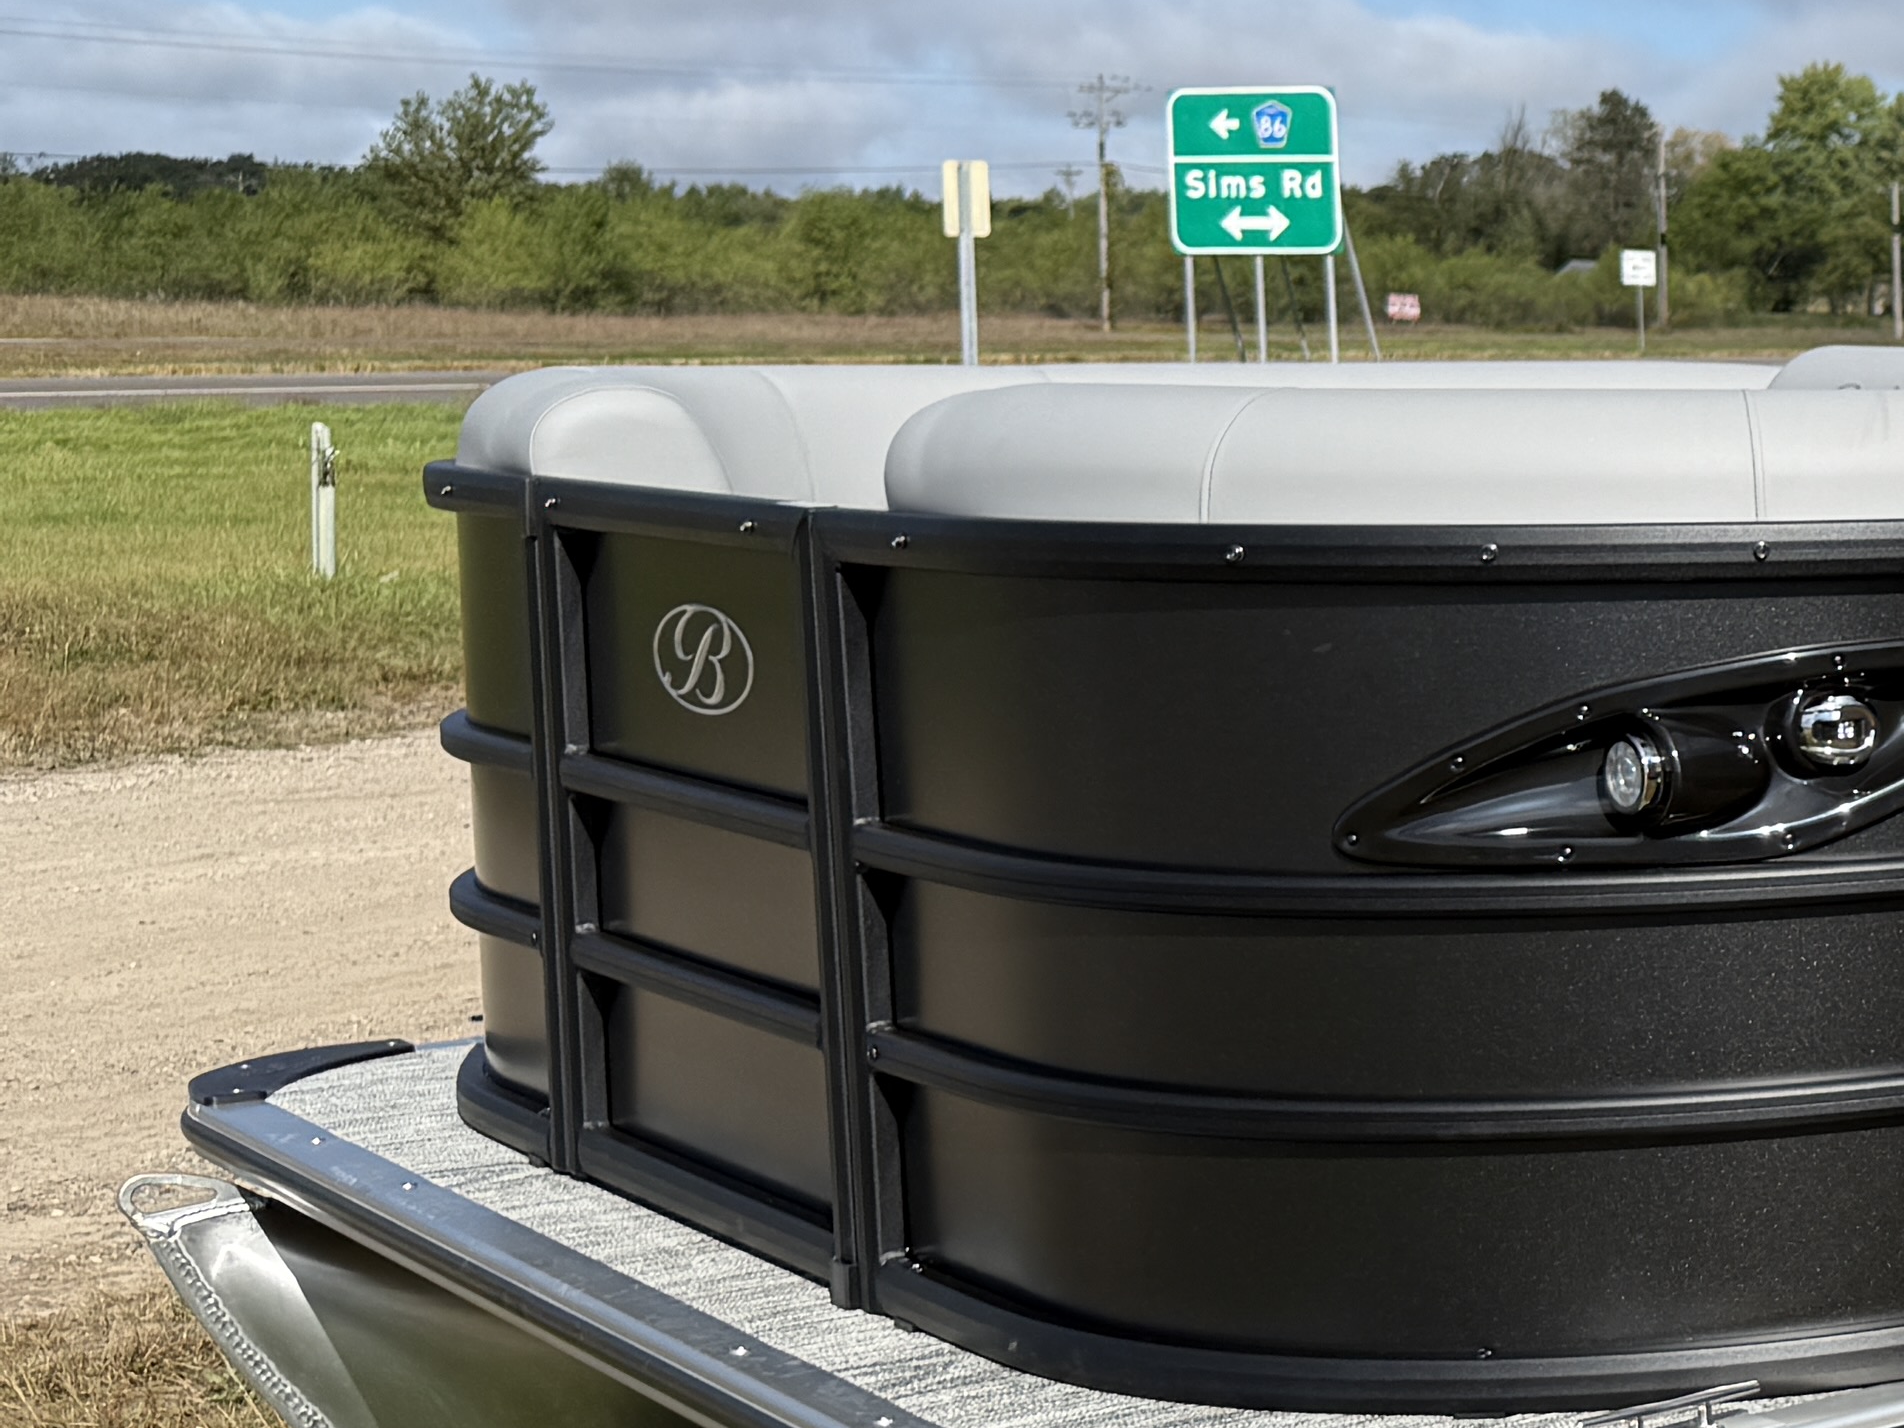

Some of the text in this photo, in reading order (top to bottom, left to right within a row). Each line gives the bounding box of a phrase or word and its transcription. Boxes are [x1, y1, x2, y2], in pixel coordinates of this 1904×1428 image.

[1260, 115, 1287, 139] 86
[1184, 168, 1324, 199] Sims Rd
